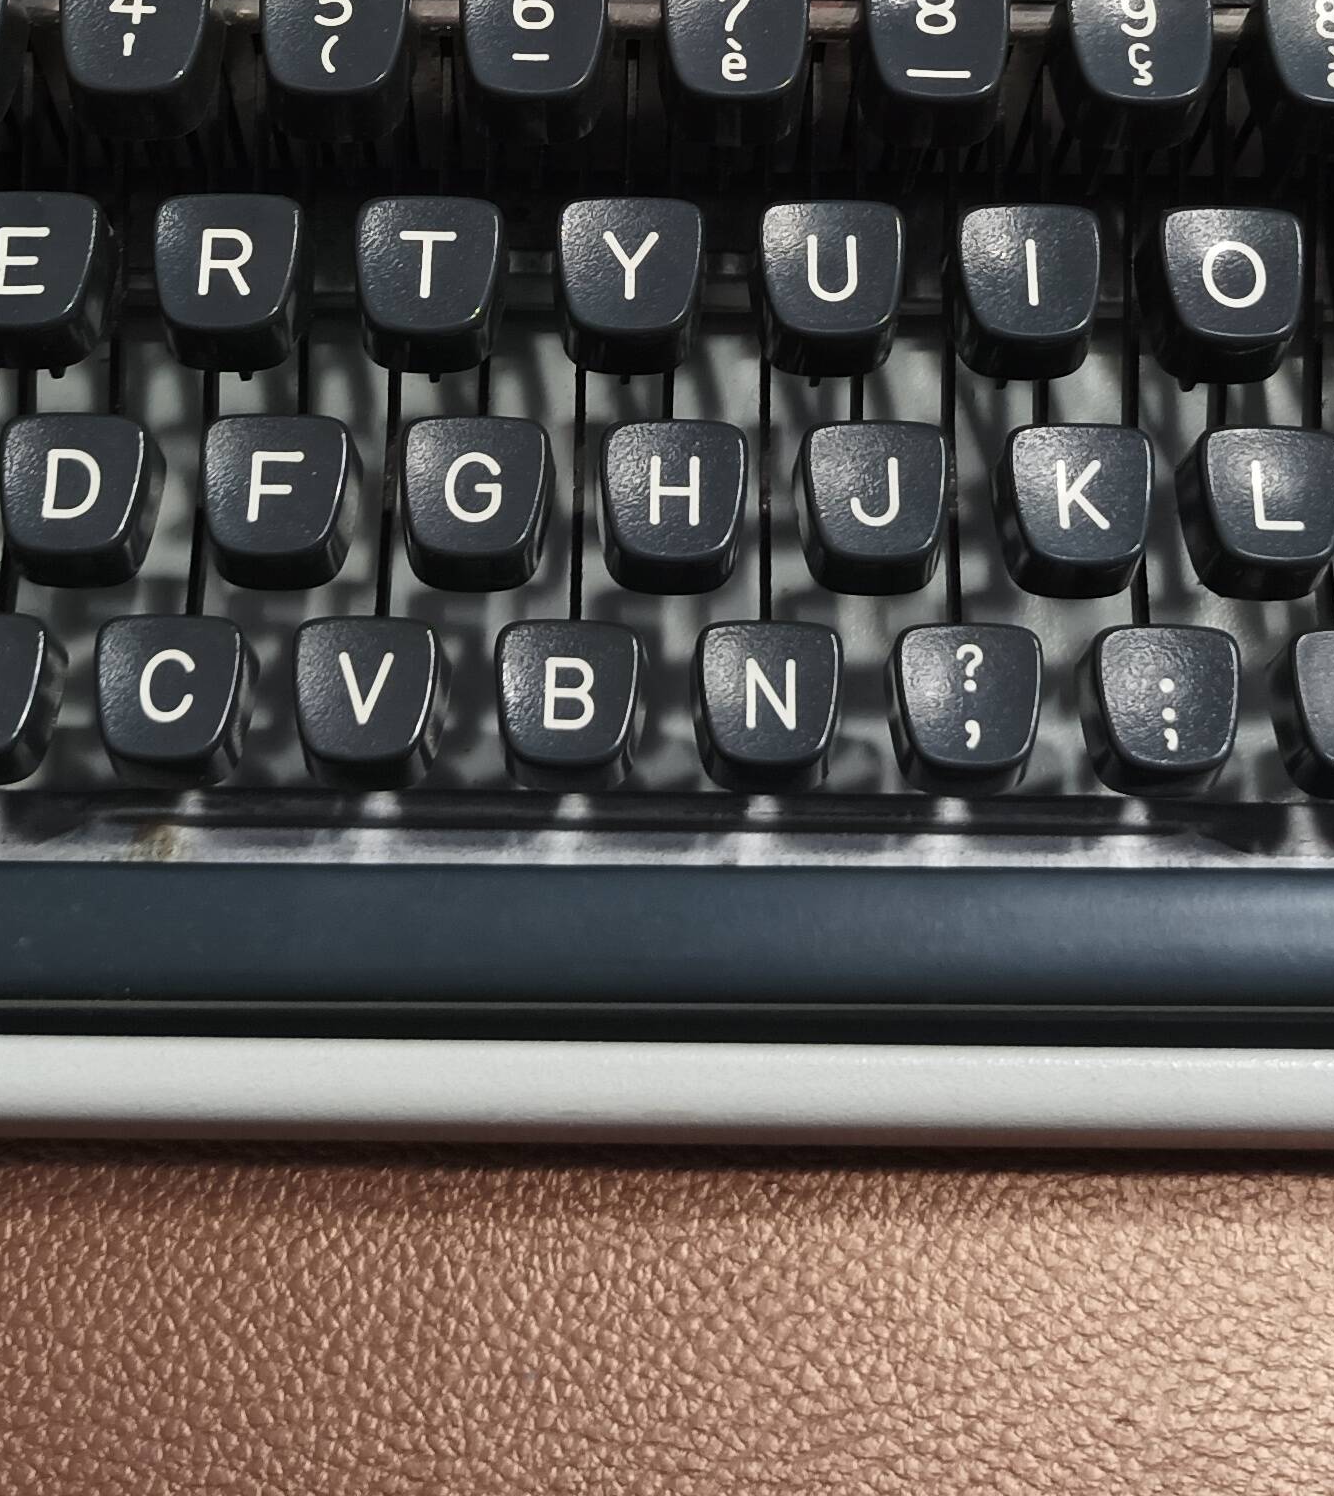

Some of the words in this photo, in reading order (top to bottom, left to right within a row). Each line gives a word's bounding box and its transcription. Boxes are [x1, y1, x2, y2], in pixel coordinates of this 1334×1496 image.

[721, 37, 747, 82] è
[1127, 42, 1154, 86] ç
[197, 228, 253, 296] R
[399, 230, 457, 299] T
[602, 230, 660, 301] Y
[805, 233, 858, 302] U
[1024, 238, 1040, 307] I
[1201, 241, 1267, 309] O
[41, 448, 101, 519] D
[246, 450, 305, 523] F
[444, 451, 502, 523] G
[647, 454, 701, 527] H
[850, 456, 900, 527] J
[1053, 459, 1111, 530] K
[1251, 459, 1306, 532] L
[139, 649, 196, 723] C
[338, 651, 395, 725] V
[543, 656, 595, 730] B
[745, 657, 797, 730] N
[955, 643, 984, 693] ?
